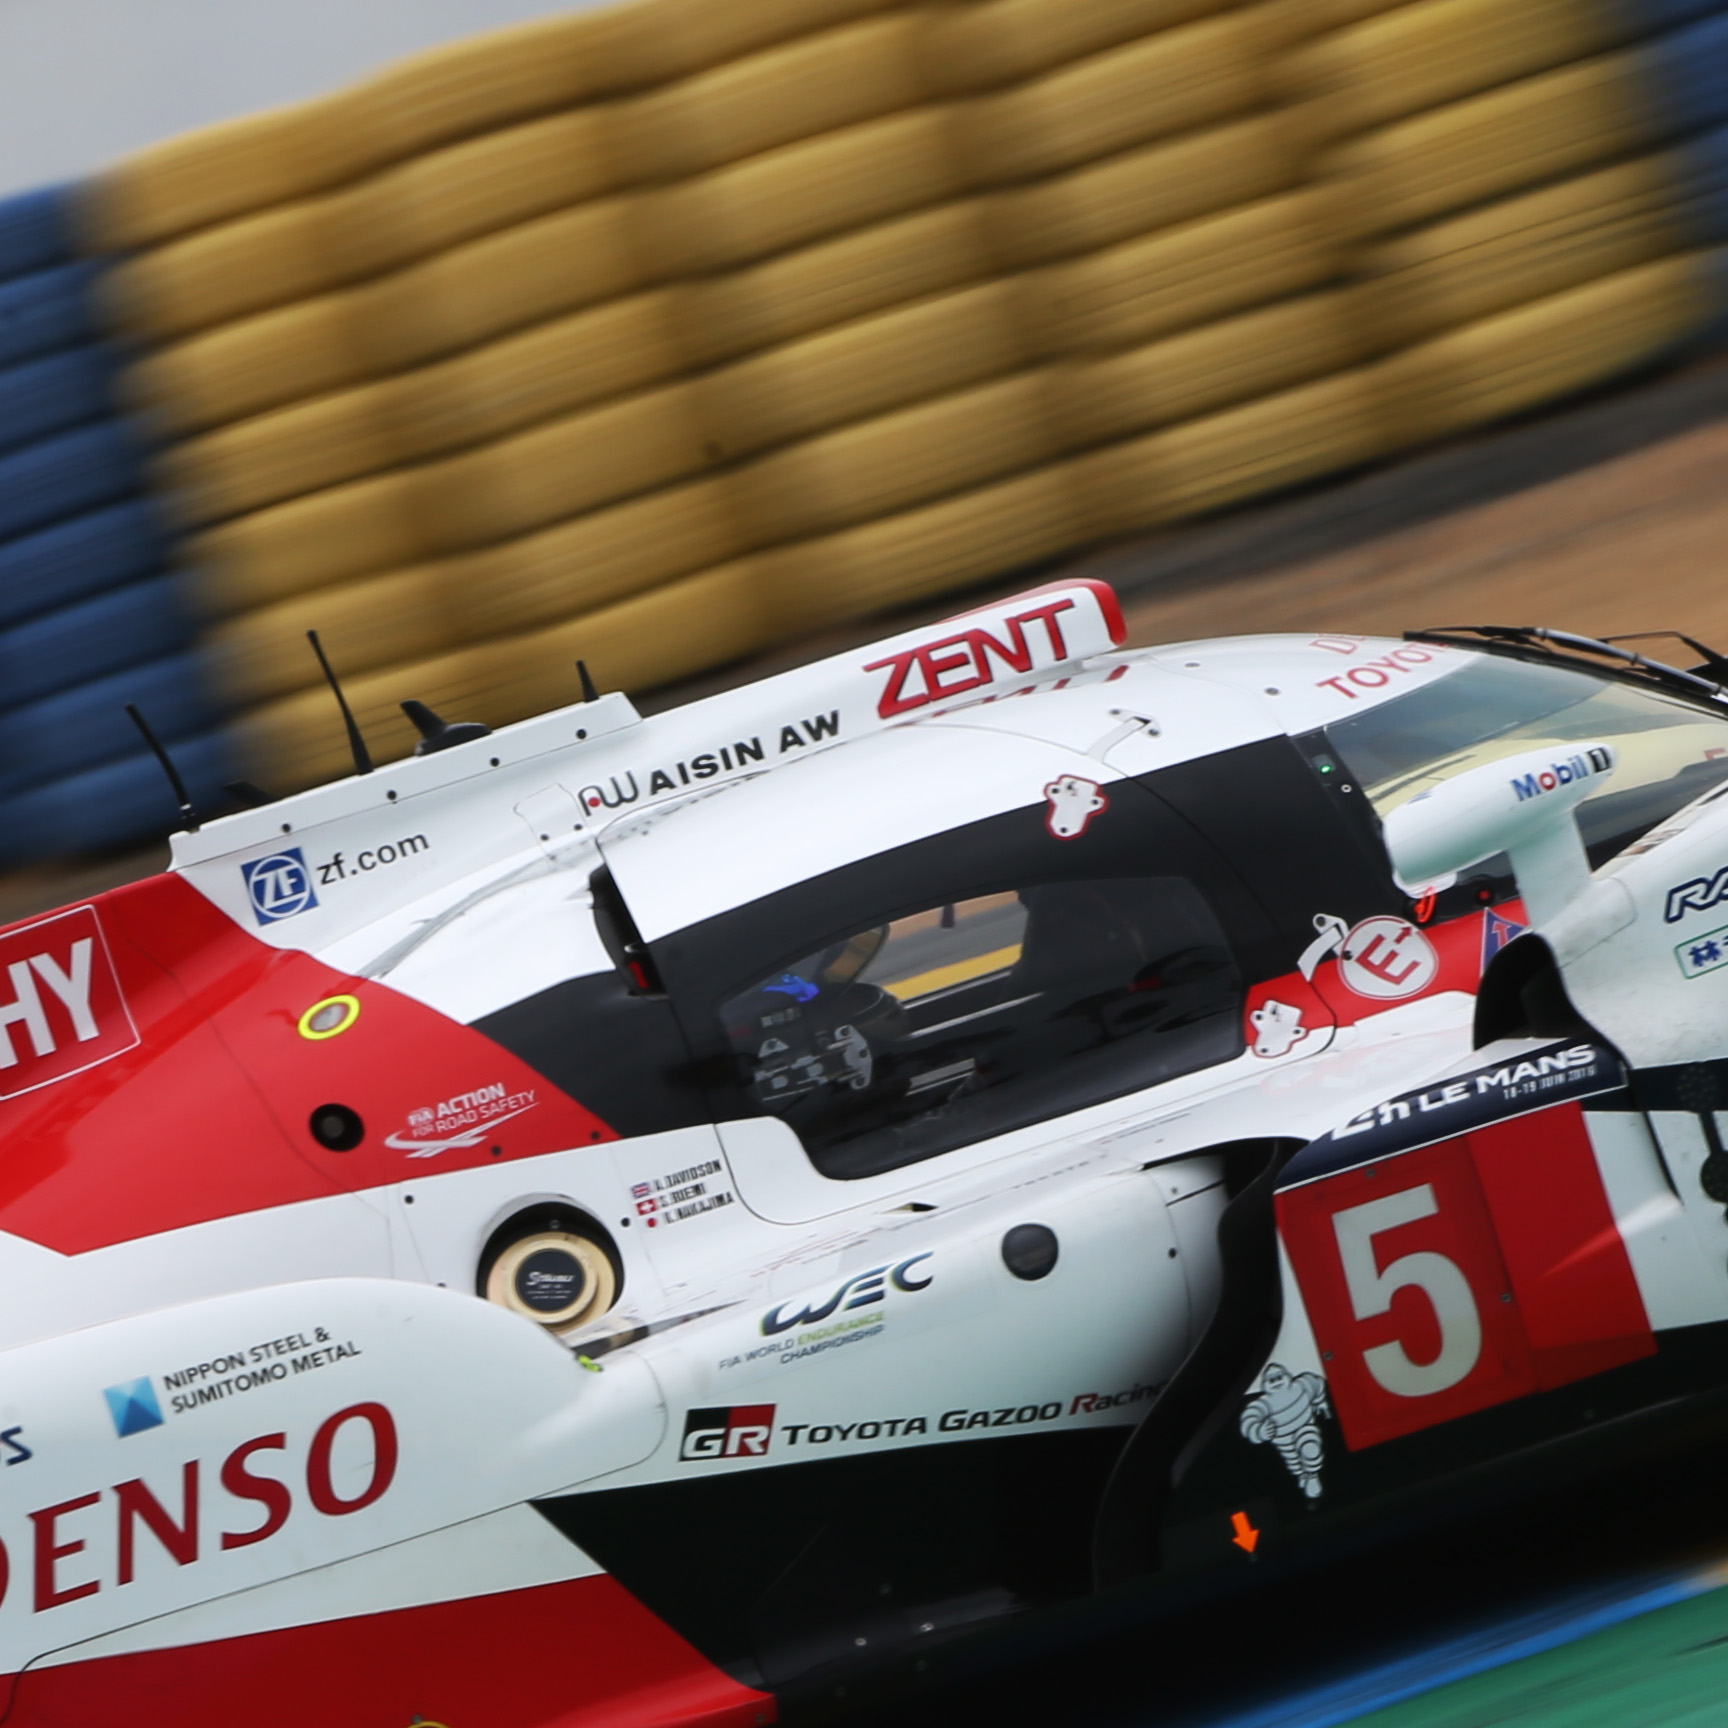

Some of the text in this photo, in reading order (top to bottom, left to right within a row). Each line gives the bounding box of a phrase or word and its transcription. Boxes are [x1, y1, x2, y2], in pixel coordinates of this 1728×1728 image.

[862, 598, 1075, 719] ZENT
[649, 737, 765, 794] AISIN
[778, 710, 839, 752] AW
[1510, 747, 1610, 801] Mobil 1
[251, 866, 299, 912] ZF
[316, 831, 430, 889] zf.com
[437, 1081, 506, 1118] ACTION
[1419, 1080, 1471, 1112] LE
[1477, 1044, 1597, 1094] MANS
[435, 1109, 478, 1133] ROAD
[480, 1089, 535, 1118] SAFETY
[760, 1251, 934, 1336] WEC
[1331, 1183, 1482, 1398] 5
[164, 1326, 330, 1390] NIPPON STEEL &
[745, 1338, 794, 1362] WORLD
[798, 1311, 885, 1346] ENDURANCE
[781, 1324, 884, 1364] CHAMPIONSHIP
[172, 1341, 362, 1414] SUMITOMO METAL
[681, 1424, 770, 1457] GR
